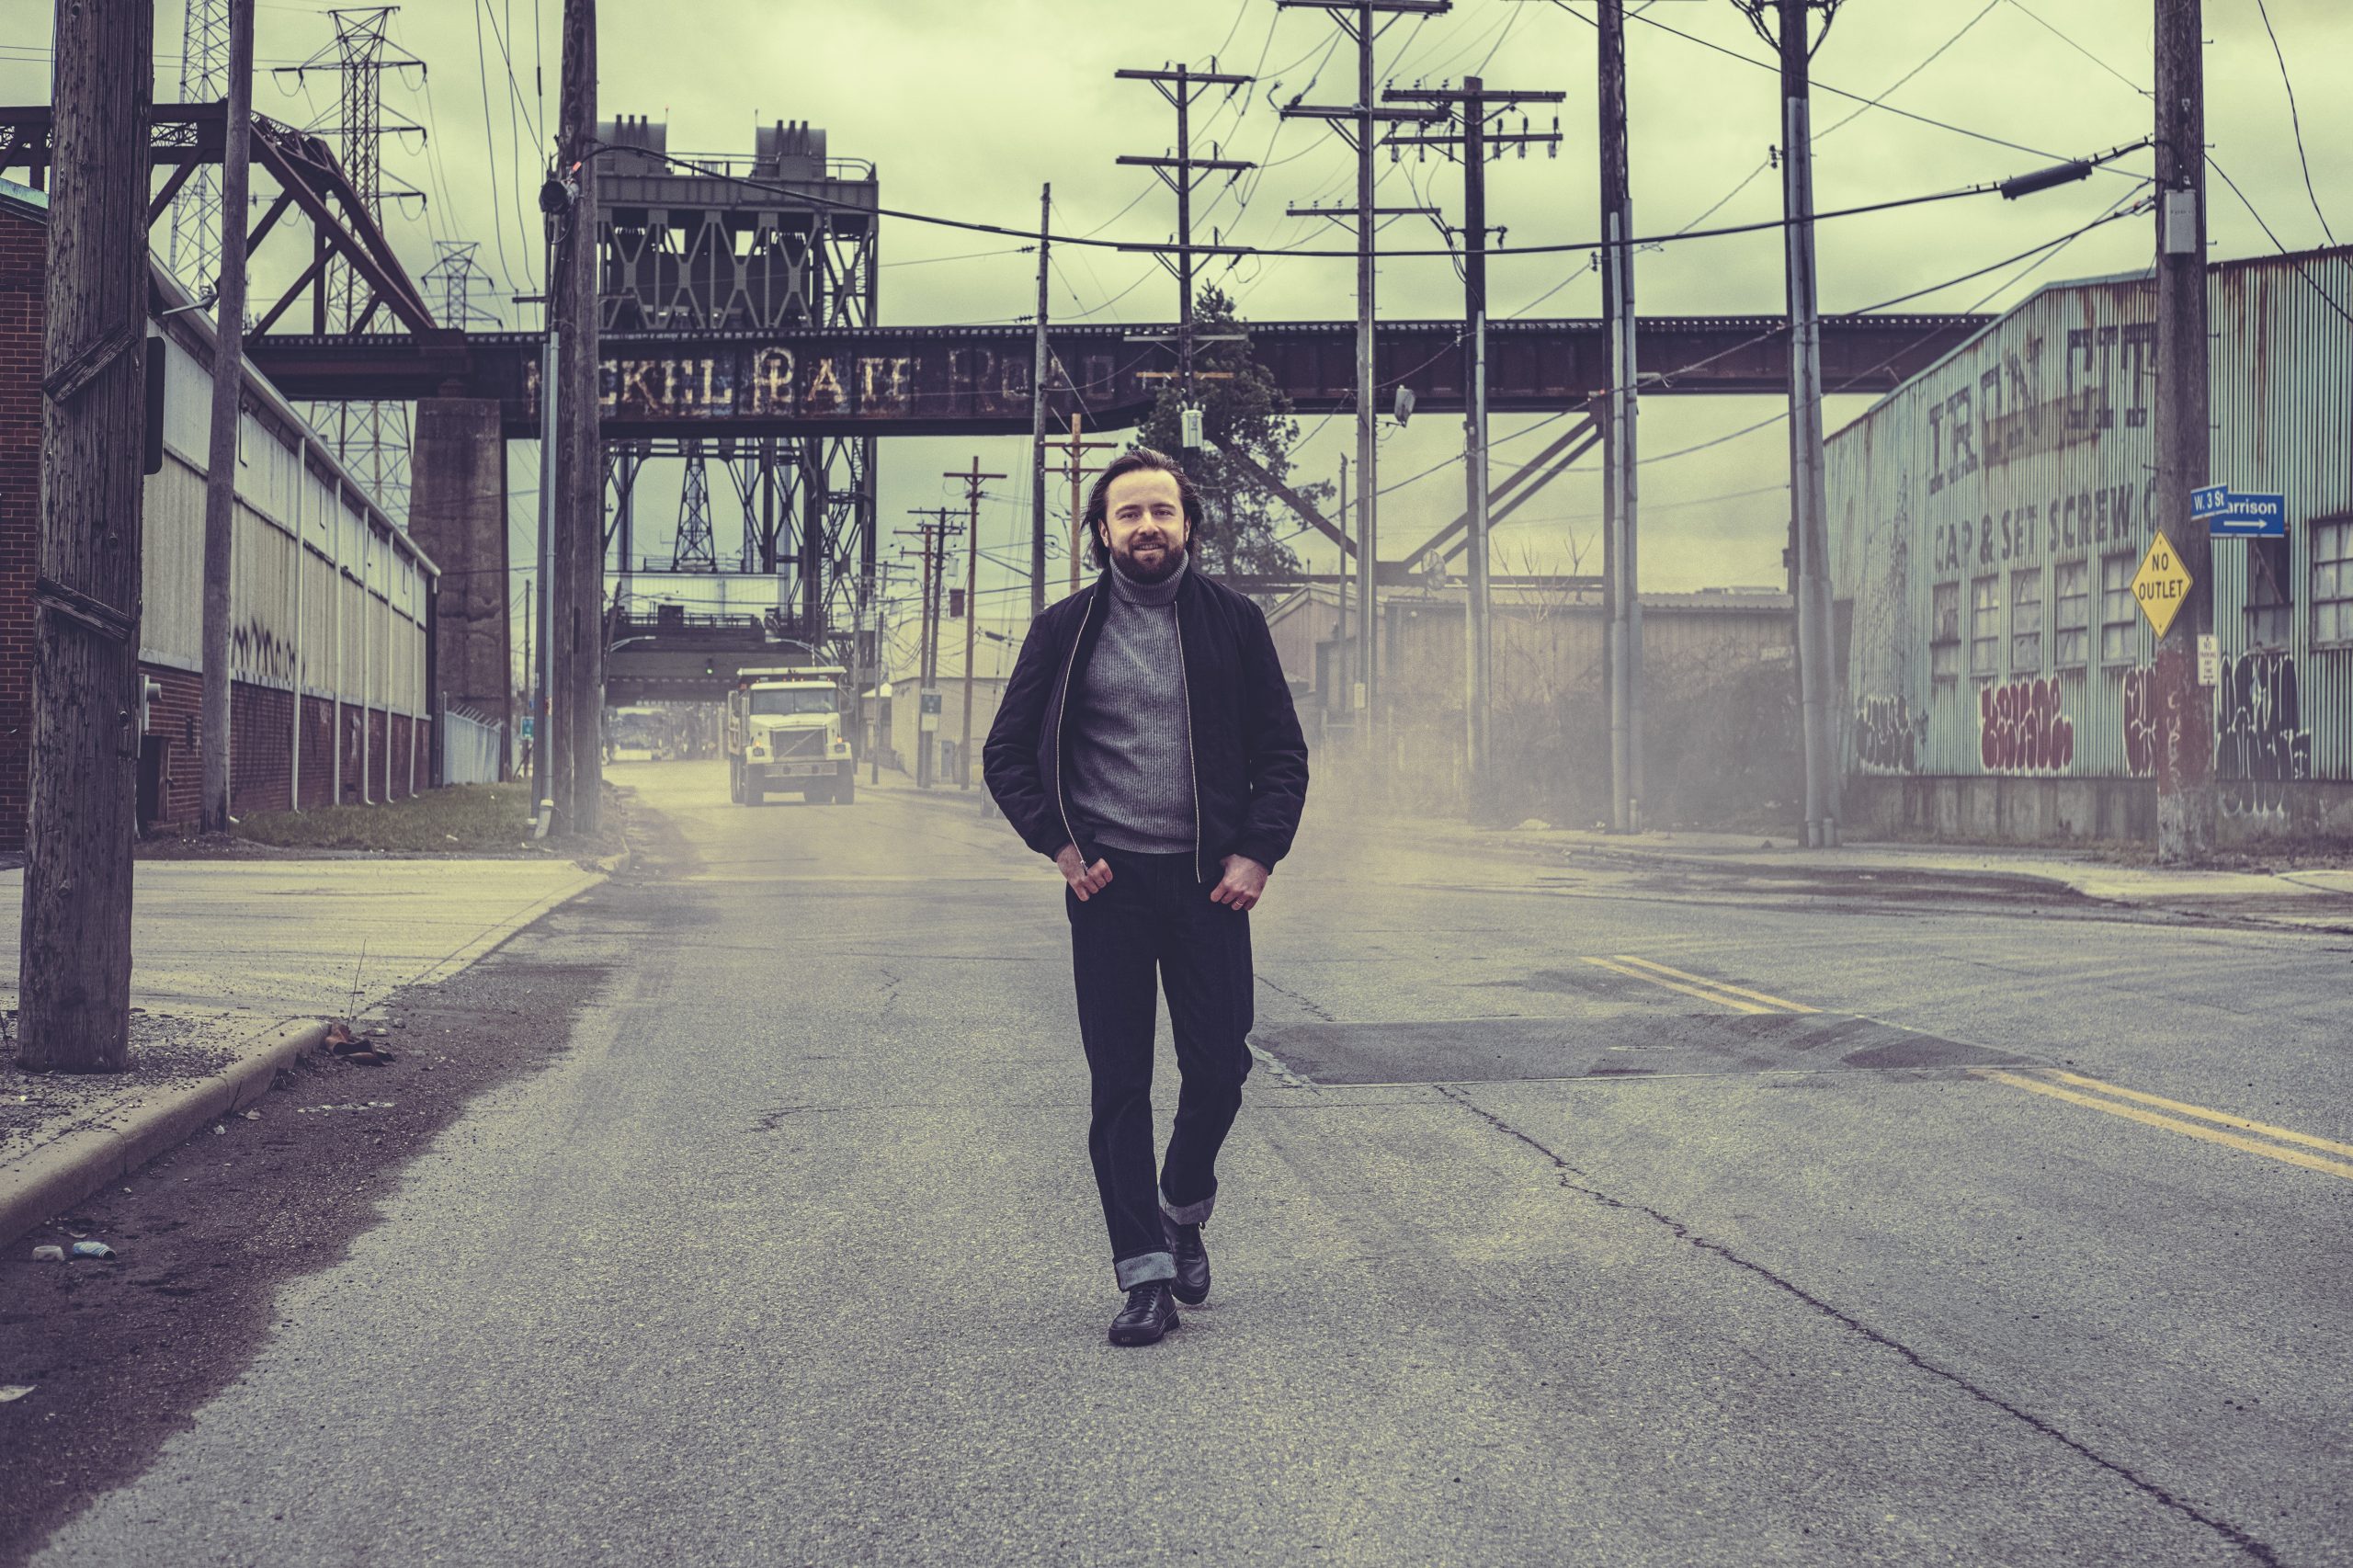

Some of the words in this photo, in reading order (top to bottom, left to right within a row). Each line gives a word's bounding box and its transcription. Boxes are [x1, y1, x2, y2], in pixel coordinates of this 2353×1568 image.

[528, 358, 733, 414] CKEL
[1929, 336, 2043, 494] IRON
[2068, 322, 2157, 429] CIT
[2194, 494, 2205, 511] W.
[2207, 493, 2213, 509] 3
[2214, 490, 2224, 506] St
[2226, 498, 2277, 516] arrison
[1936, 520, 1972, 574] CAP
[1980, 515, 1994, 565] &
[2001, 505, 2037, 561] SET
[2049, 483, 2134, 552] SCREW
[2152, 553, 2169, 571] NO
[2139, 580, 2184, 600] OUTLET
